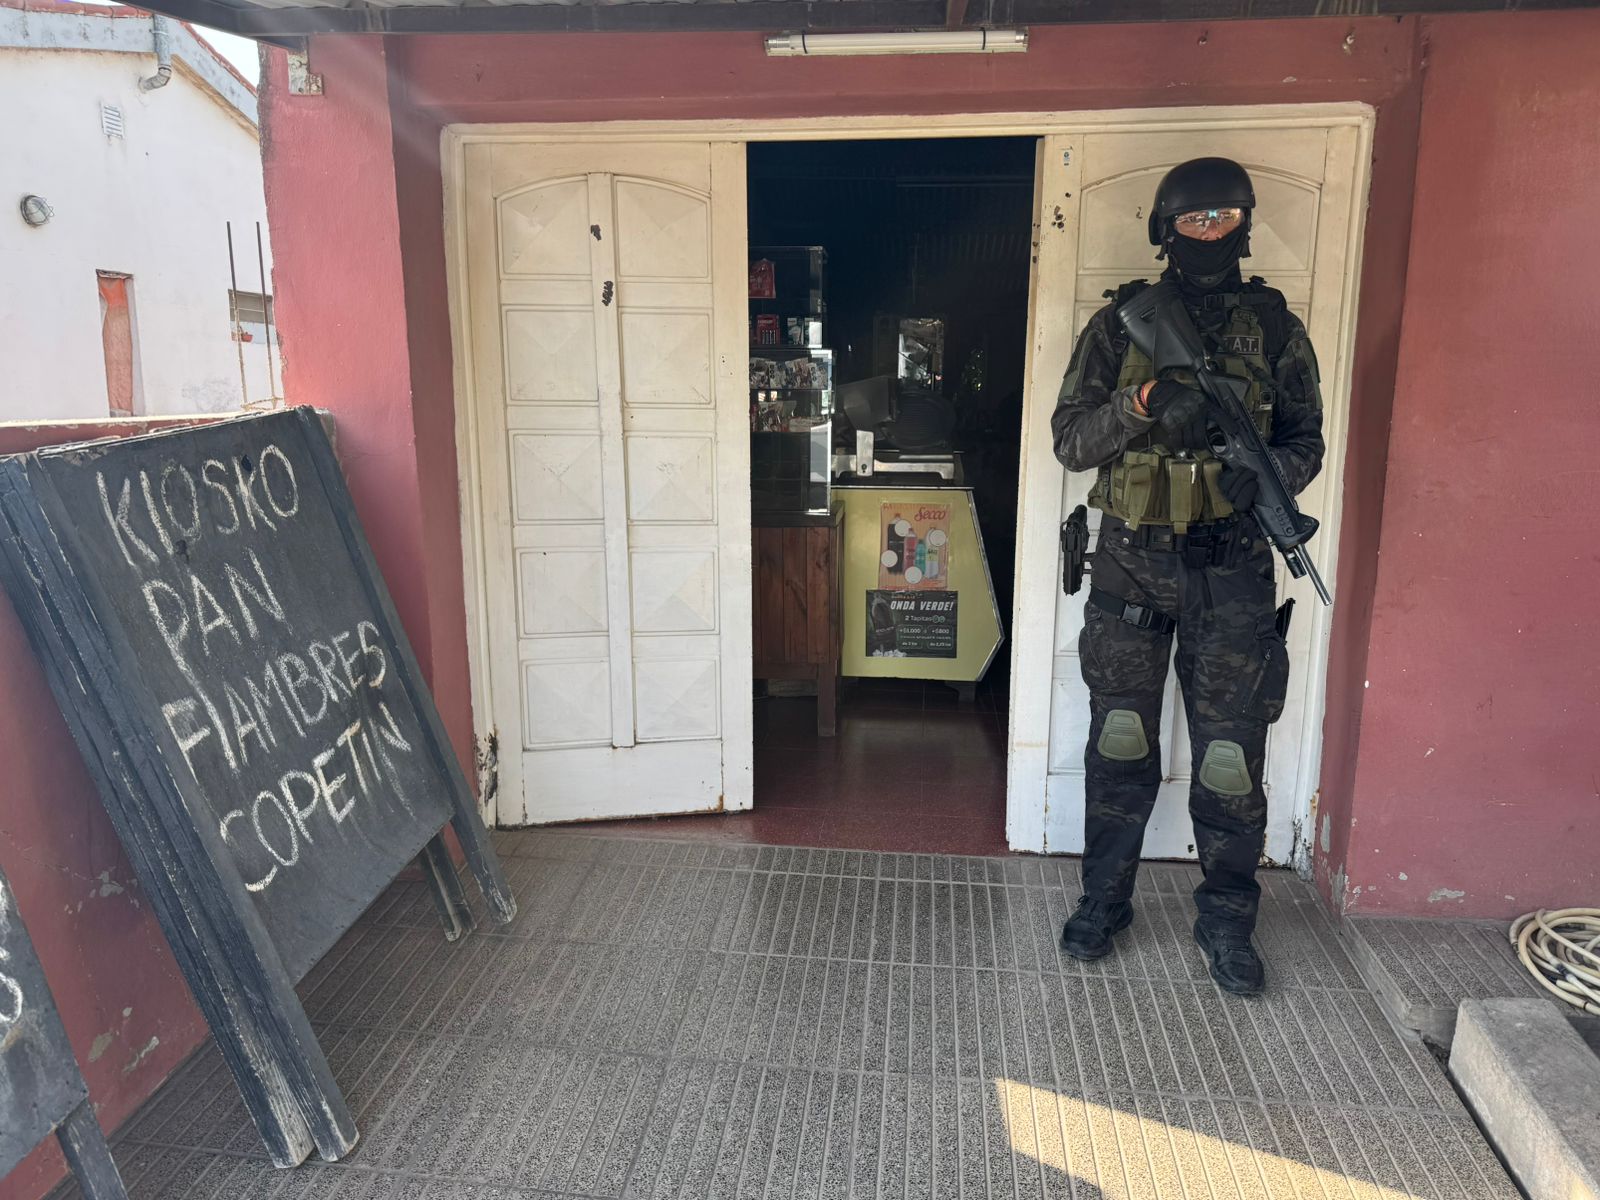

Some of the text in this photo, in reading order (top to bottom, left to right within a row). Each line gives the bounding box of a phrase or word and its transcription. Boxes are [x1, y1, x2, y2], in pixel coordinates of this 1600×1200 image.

[1224, 337, 1257, 352] A.T.
[96, 444, 299, 567] KIOSKO
[914, 507, 946, 521] Secco
[141, 547, 293, 682] PAN
[890, 601, 954, 610] ONDA VERDE!
[162, 621, 387, 785] FIAMBRES
[220, 701, 416, 893] COPETIN
